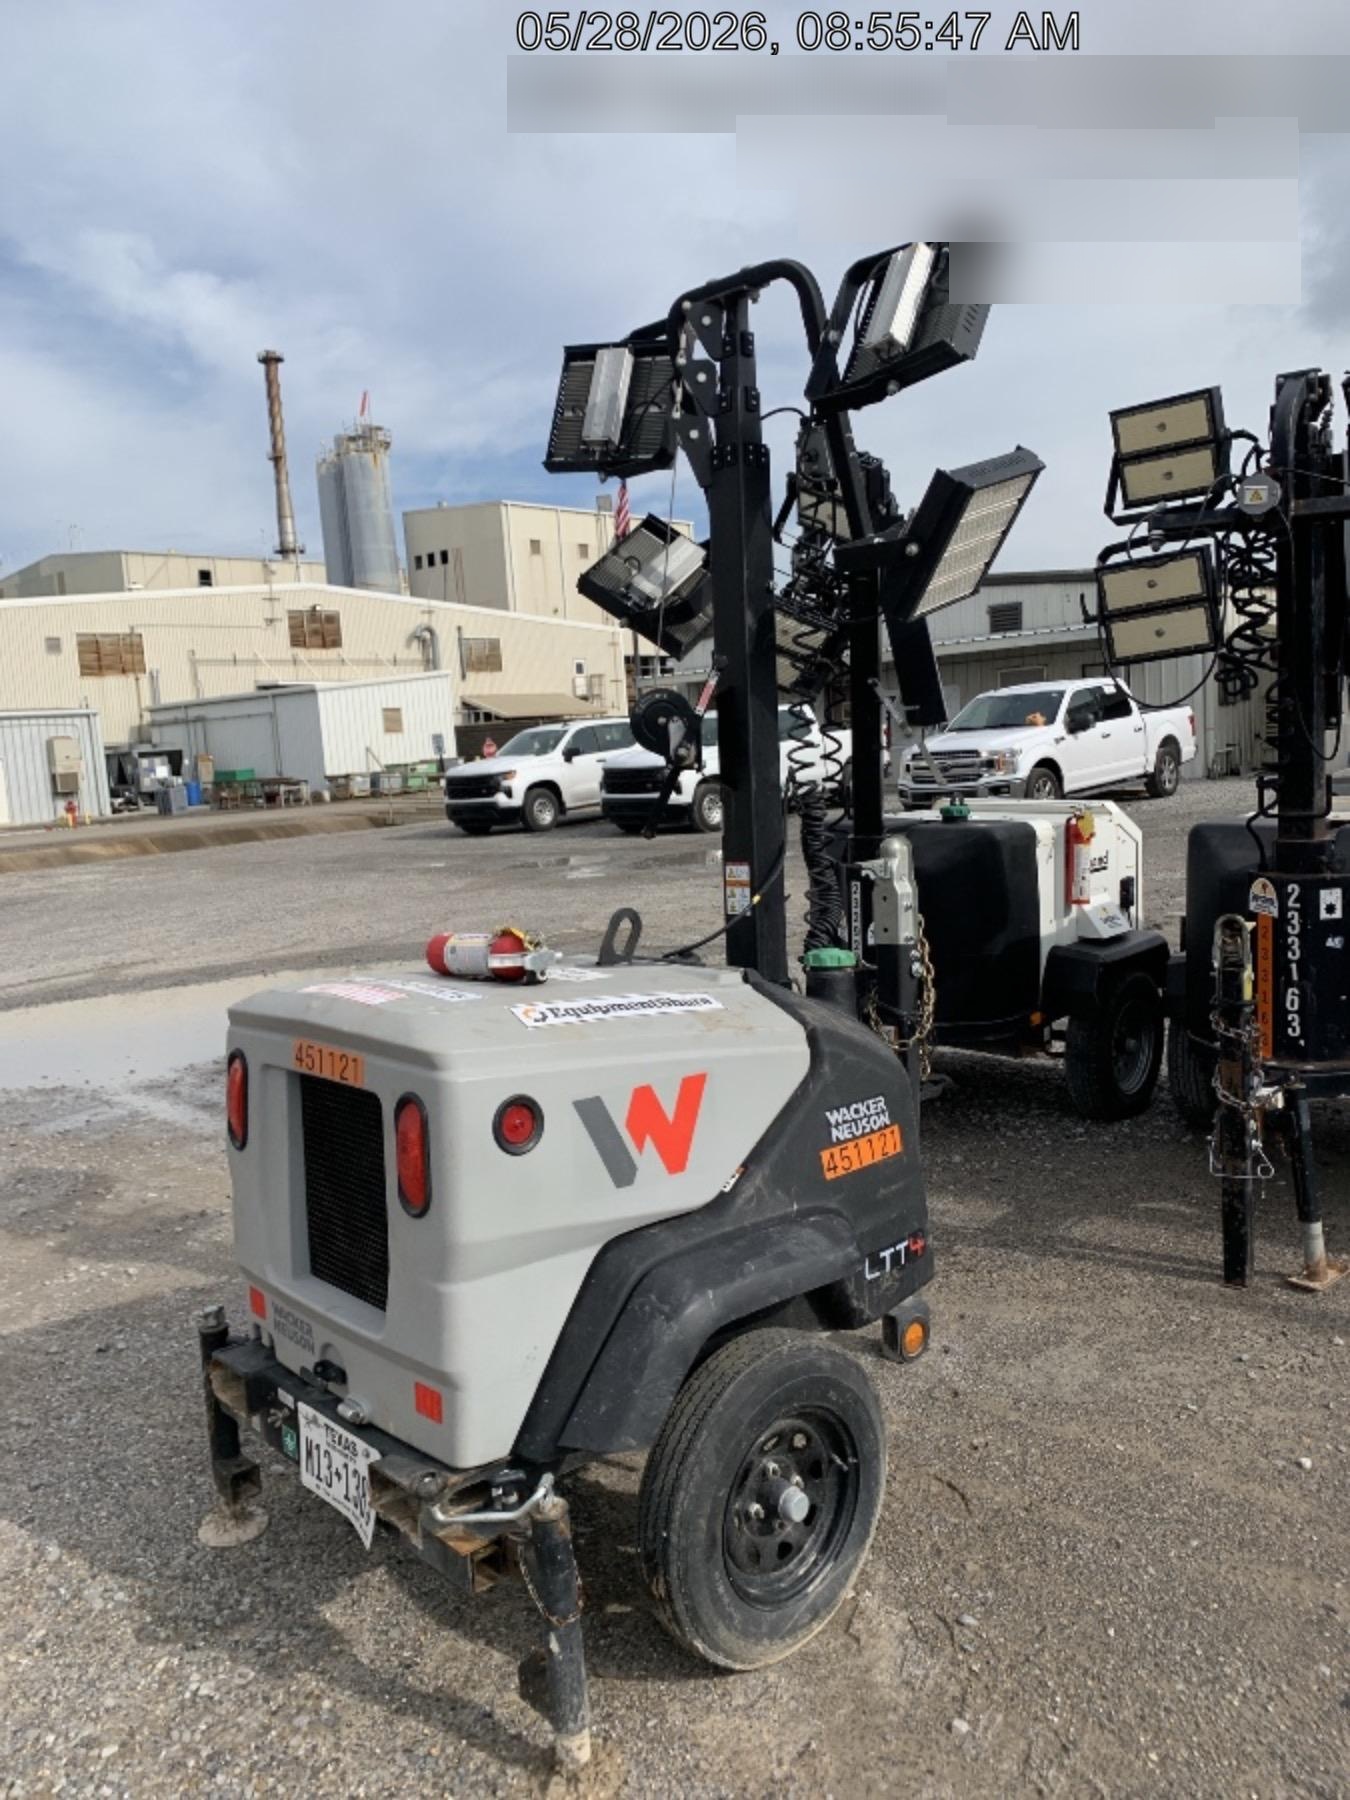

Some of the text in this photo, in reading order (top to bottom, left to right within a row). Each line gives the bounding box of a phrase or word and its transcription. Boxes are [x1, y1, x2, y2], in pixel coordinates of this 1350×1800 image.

[1285, 883, 1301, 1038] 233163
[294, 1041, 361, 1084] 451121
[825, 1096, 887, 1127] WACKER
[830, 1111, 891, 1143] NEUSON
[825, 1128, 899, 1175] 451121
[323, 1422, 360, 1459] TEXAS
